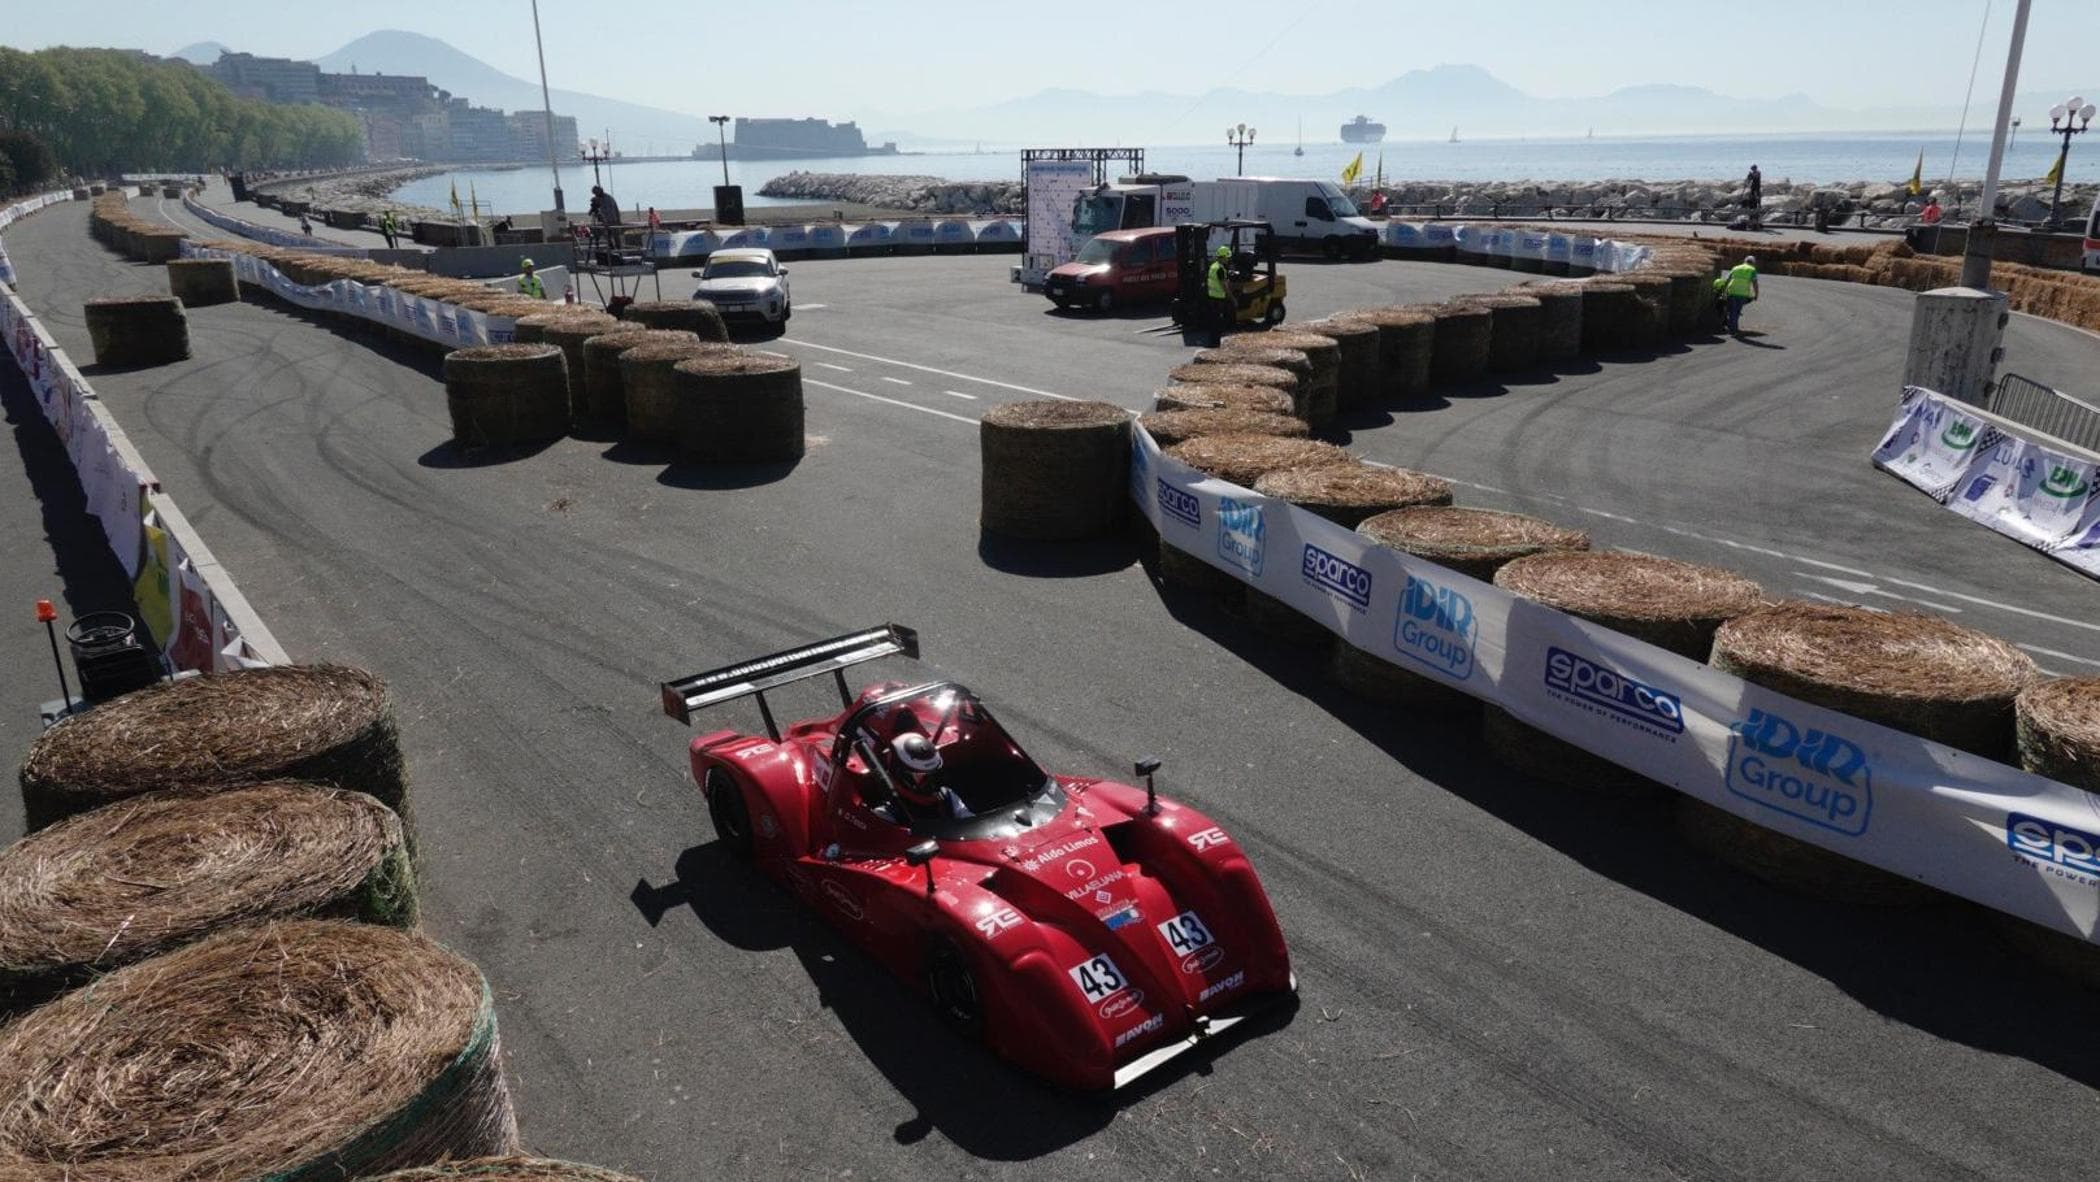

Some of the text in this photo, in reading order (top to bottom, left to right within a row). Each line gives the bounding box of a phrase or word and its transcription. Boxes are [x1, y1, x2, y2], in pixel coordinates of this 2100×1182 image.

[1305, 548, 1370, 596] sparco
[1402, 619, 1467, 669] Group
[1549, 653, 1680, 719] sparco
[1740, 756, 1857, 821] Group
[1037, 848, 1065, 864] Aldo
[2013, 821, 2100, 864] sp
[2046, 865, 2097, 886] POWER
[1167, 914, 1208, 951] 43
[1078, 957, 1122, 997] 43
